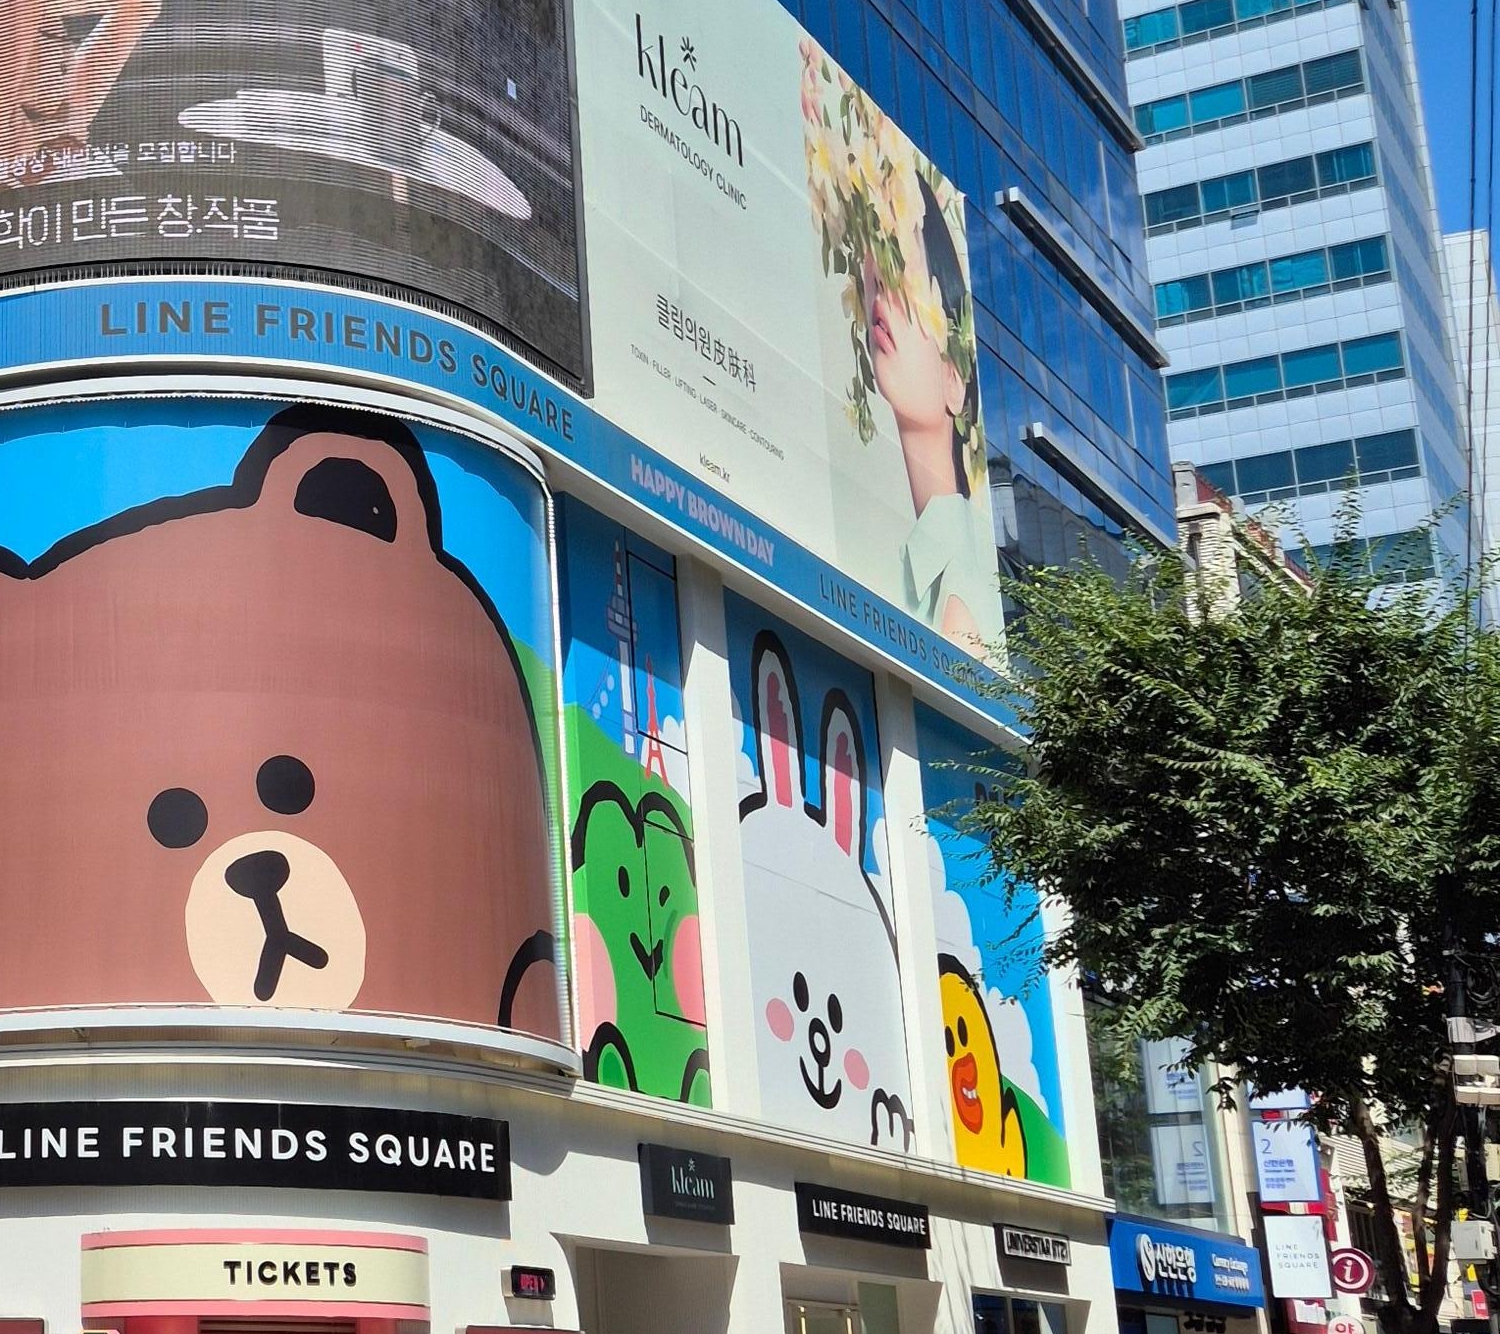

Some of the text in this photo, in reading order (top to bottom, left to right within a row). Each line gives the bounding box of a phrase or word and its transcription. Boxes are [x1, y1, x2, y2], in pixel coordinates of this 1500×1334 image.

[635, 13, 744, 168] kleam
[137, 141, 237, 164] 모집합니다
[639, 104, 748, 210] DERMATOLOGY CLINIC
[72, 196, 149, 242] 만든
[100, 300, 578, 444] LINE FRIENDS SQUARE
[699, 451, 731, 484] kleam.kr
[630, 453, 776, 567] HAPPY BROWN DAY
[819, 573, 859, 619] LINE
[863, 599, 928, 662] FRIENDS
[121, 1124, 329, 1163] FRIENDS
[348, 1130, 497, 1173] SQUARE
[1260, 1138, 1273, 1155] 2
[671, 1165, 715, 1199] kleam
[812, 1198, 927, 1236] LINE FRIENDS SQUARE
[1155, 1242, 1197, 1283] 신한은행
[1275, 1243, 1299, 1251] LINE
[1278, 1261, 1319, 1269] SQUARE
[223, 1259, 358, 1287] TICKETS
